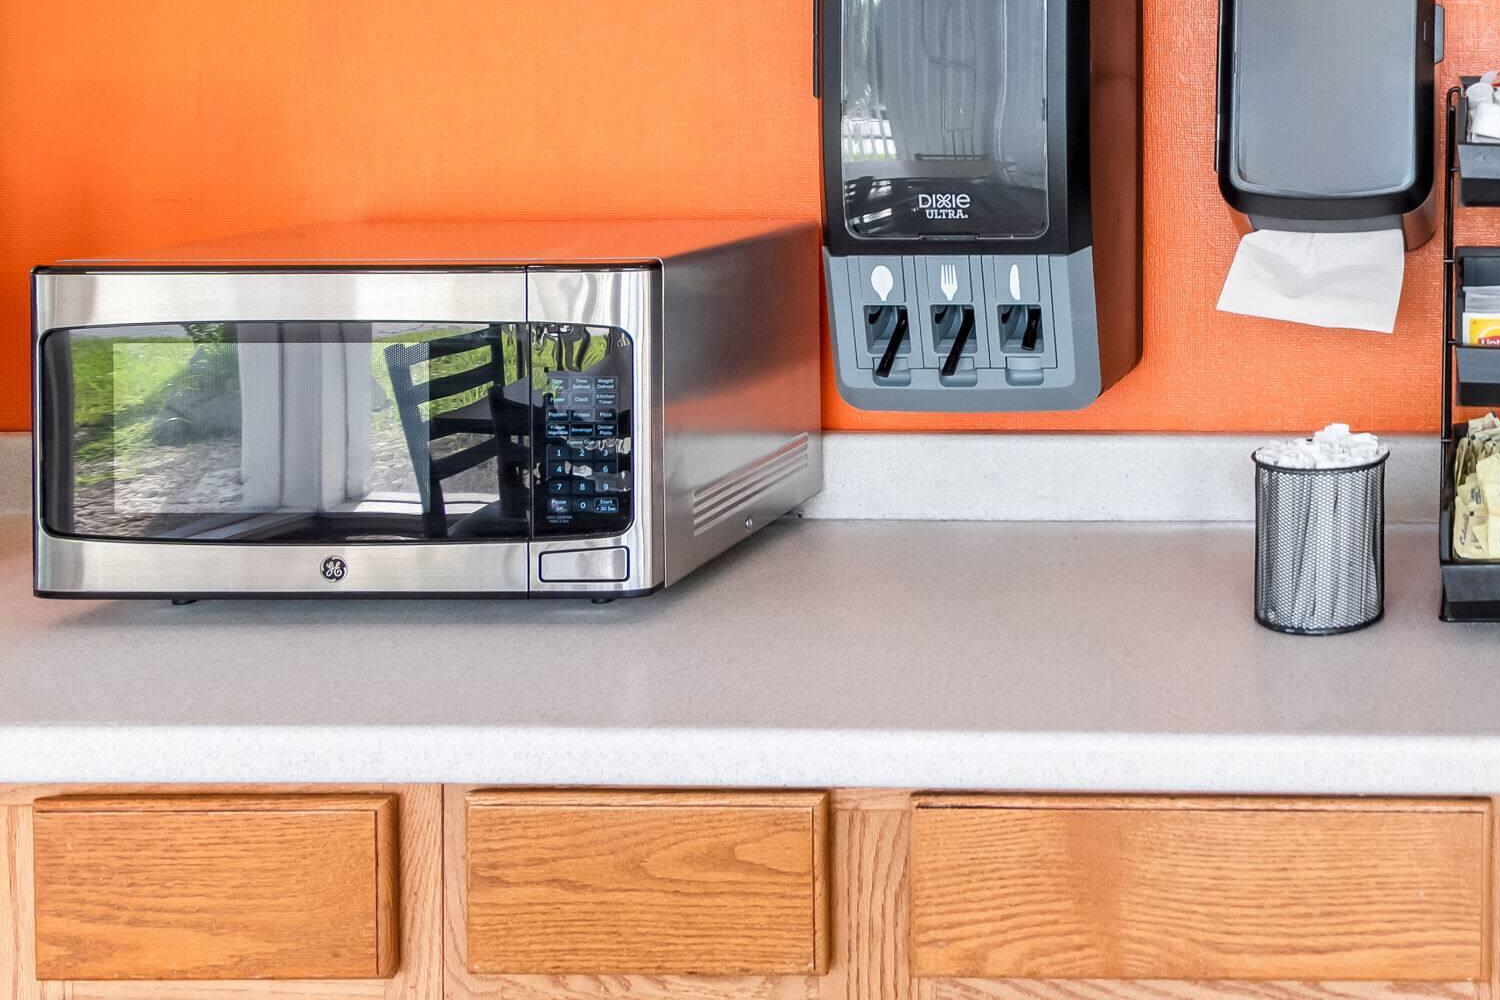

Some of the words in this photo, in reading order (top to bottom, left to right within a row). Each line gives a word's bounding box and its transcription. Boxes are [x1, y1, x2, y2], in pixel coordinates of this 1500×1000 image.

[556, 449, 562, 457] 1
[579, 449, 585, 457] 2
[603, 449, 609, 457] 3
[556, 465, 562, 473] 4
[602, 465, 609, 473] 6
[556, 483, 562, 491] 7
[579, 483, 586, 491] 8
[602, 483, 609, 491] 9
[580, 501, 586, 510] 0
